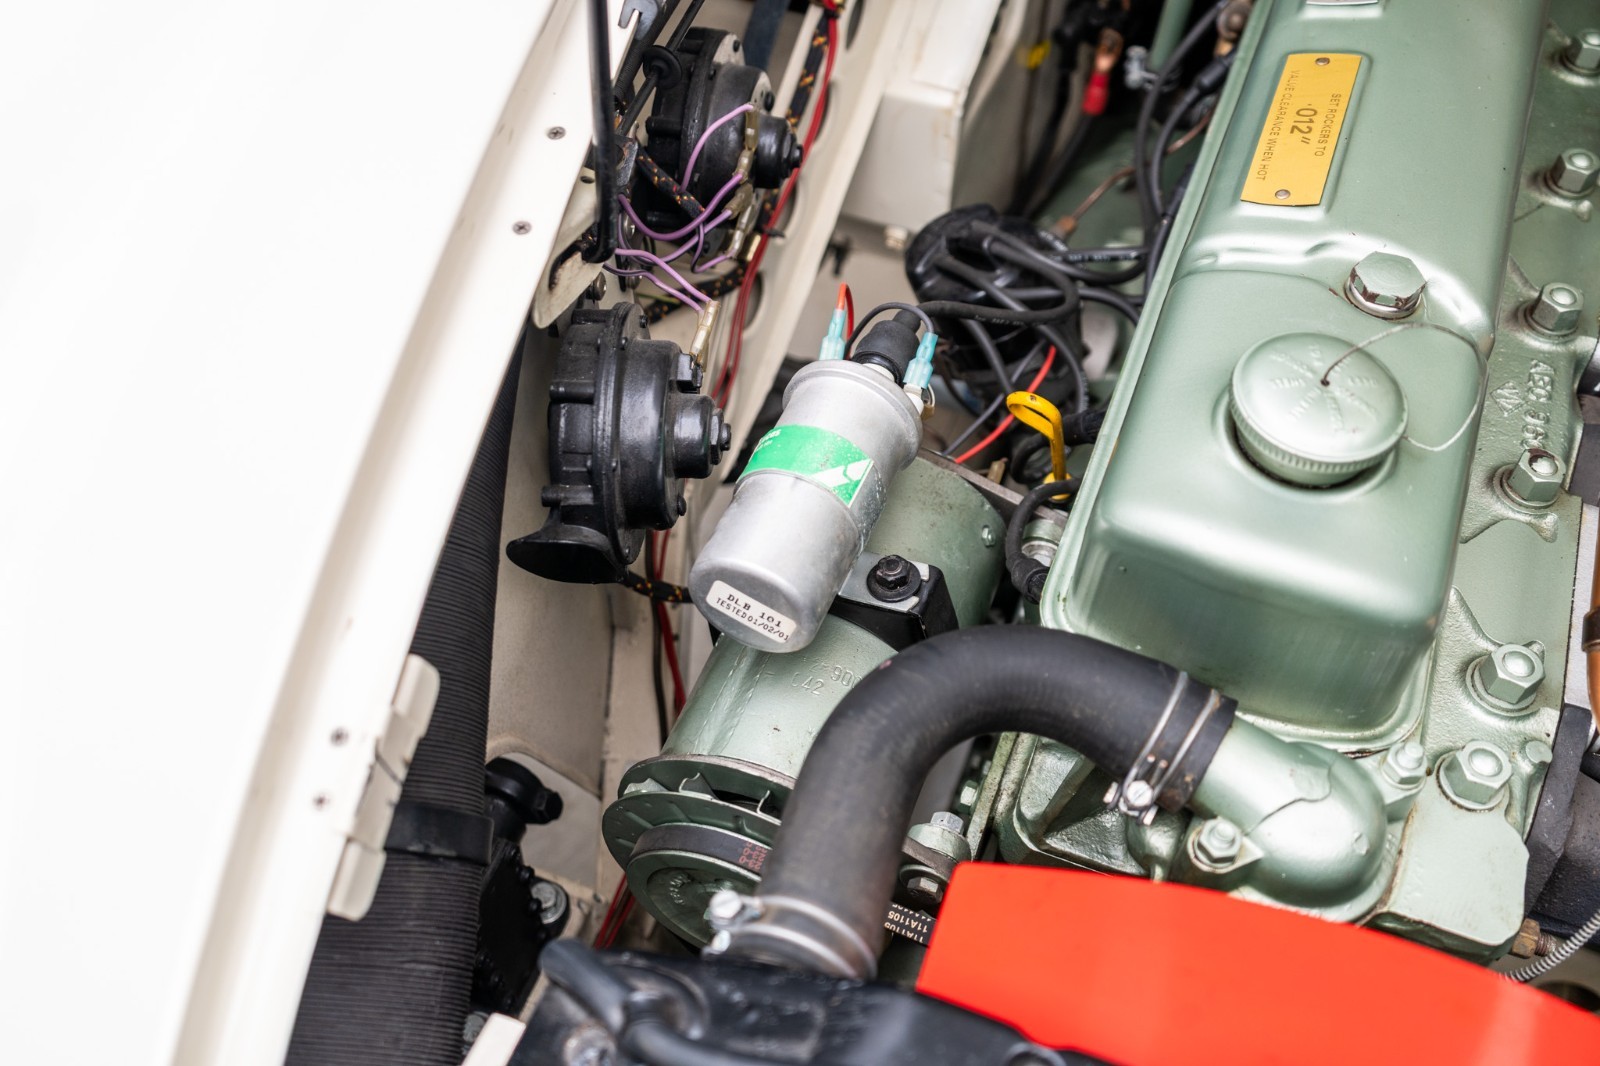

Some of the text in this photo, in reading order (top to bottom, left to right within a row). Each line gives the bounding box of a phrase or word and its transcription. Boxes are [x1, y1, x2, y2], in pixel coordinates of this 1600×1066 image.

[1256, 69, 1300, 181] VALVE CLEARANCE WHEN HOT
[1314, 93, 1341, 157] SET ROCKERS TO
[716, 597, 747, 621] TESTED
[759, 612, 782, 628] 101
[887, 911, 928, 933] 11A1105
